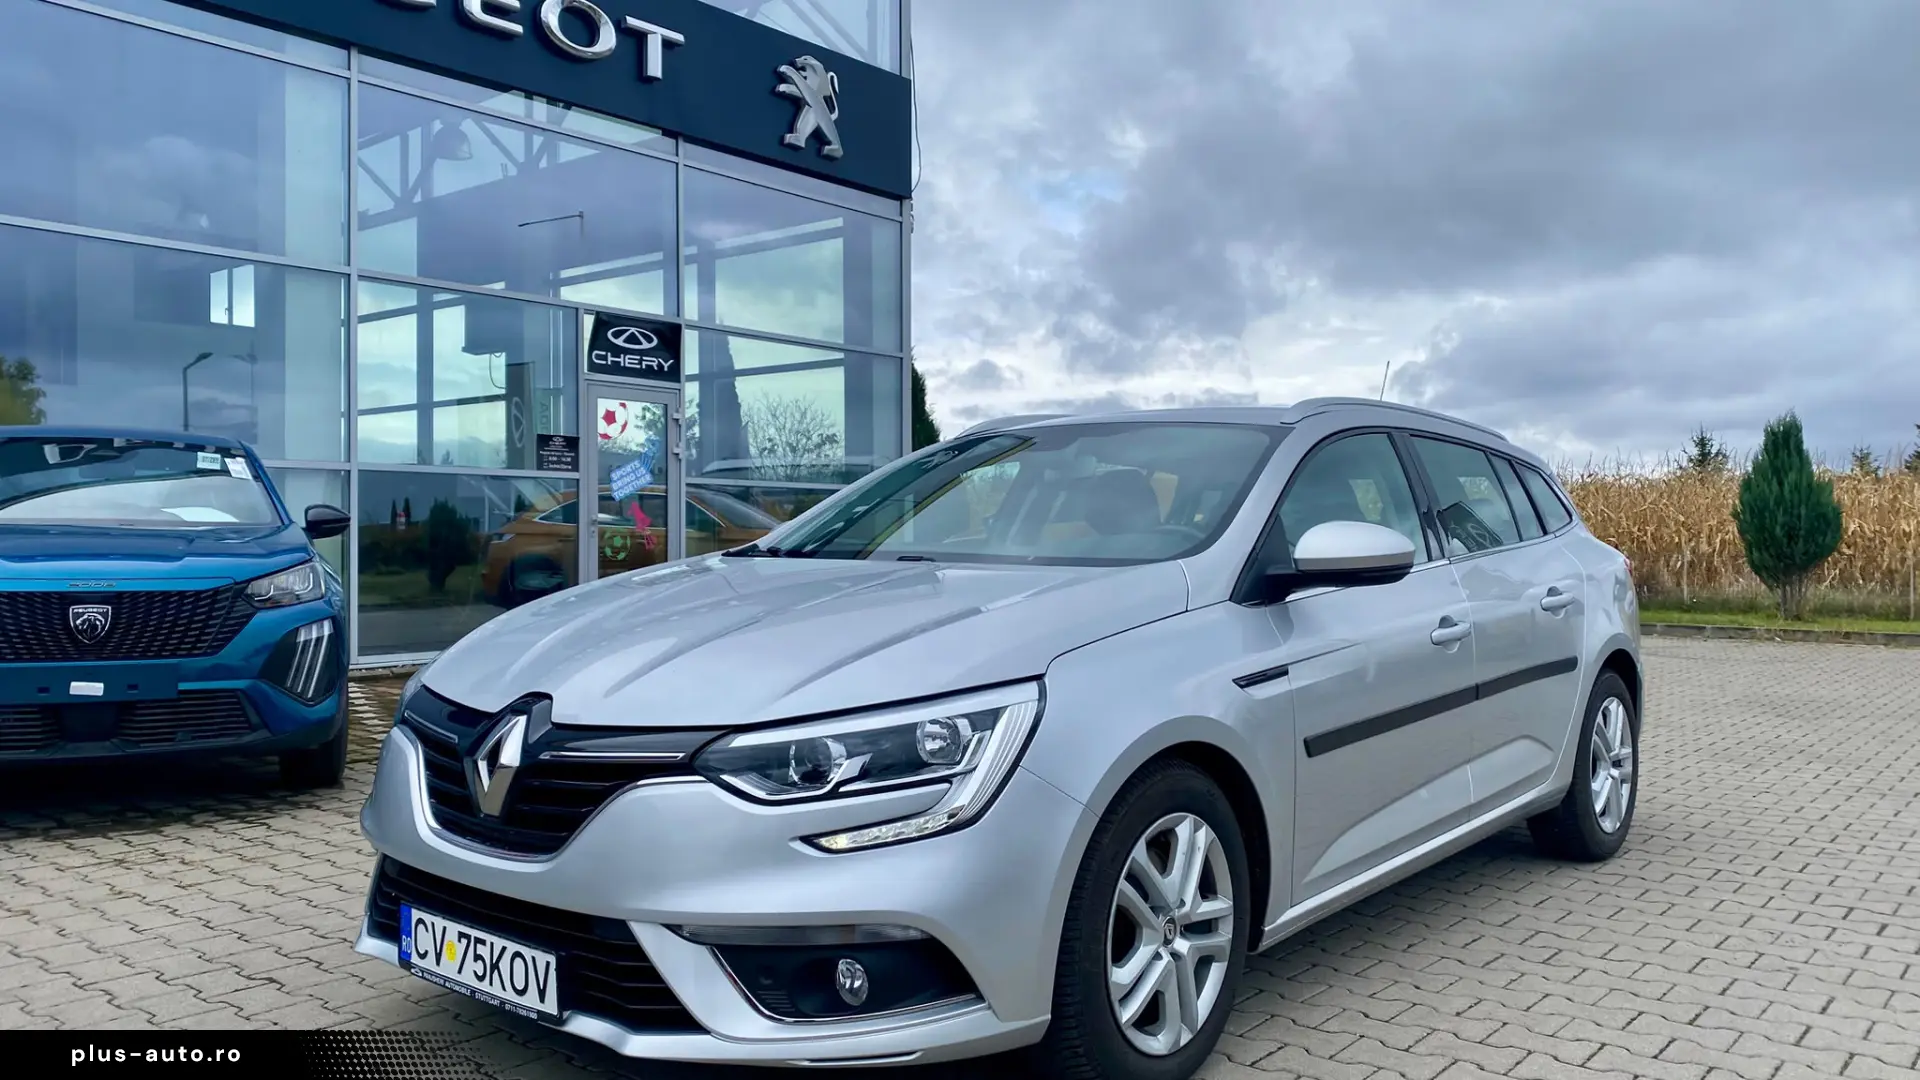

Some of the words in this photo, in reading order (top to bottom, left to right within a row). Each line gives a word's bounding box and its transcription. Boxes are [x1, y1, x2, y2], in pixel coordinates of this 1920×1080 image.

[388, 0, 685, 80] EOT
[591, 350, 674, 372] CHERY
[611, 460, 641, 480] SPORTS
[612, 472, 636, 490] BRING
[635, 467, 646, 477] US
[613, 474, 651, 500] TOGETHER
[402, 934, 412, 953] RO
[414, 917, 447, 967] CV
[457, 930, 551, 1004] 75KOV
[445, 981, 471, 996] AUTOMOBILE
[475, 992, 501, 1006] STUTTGART
